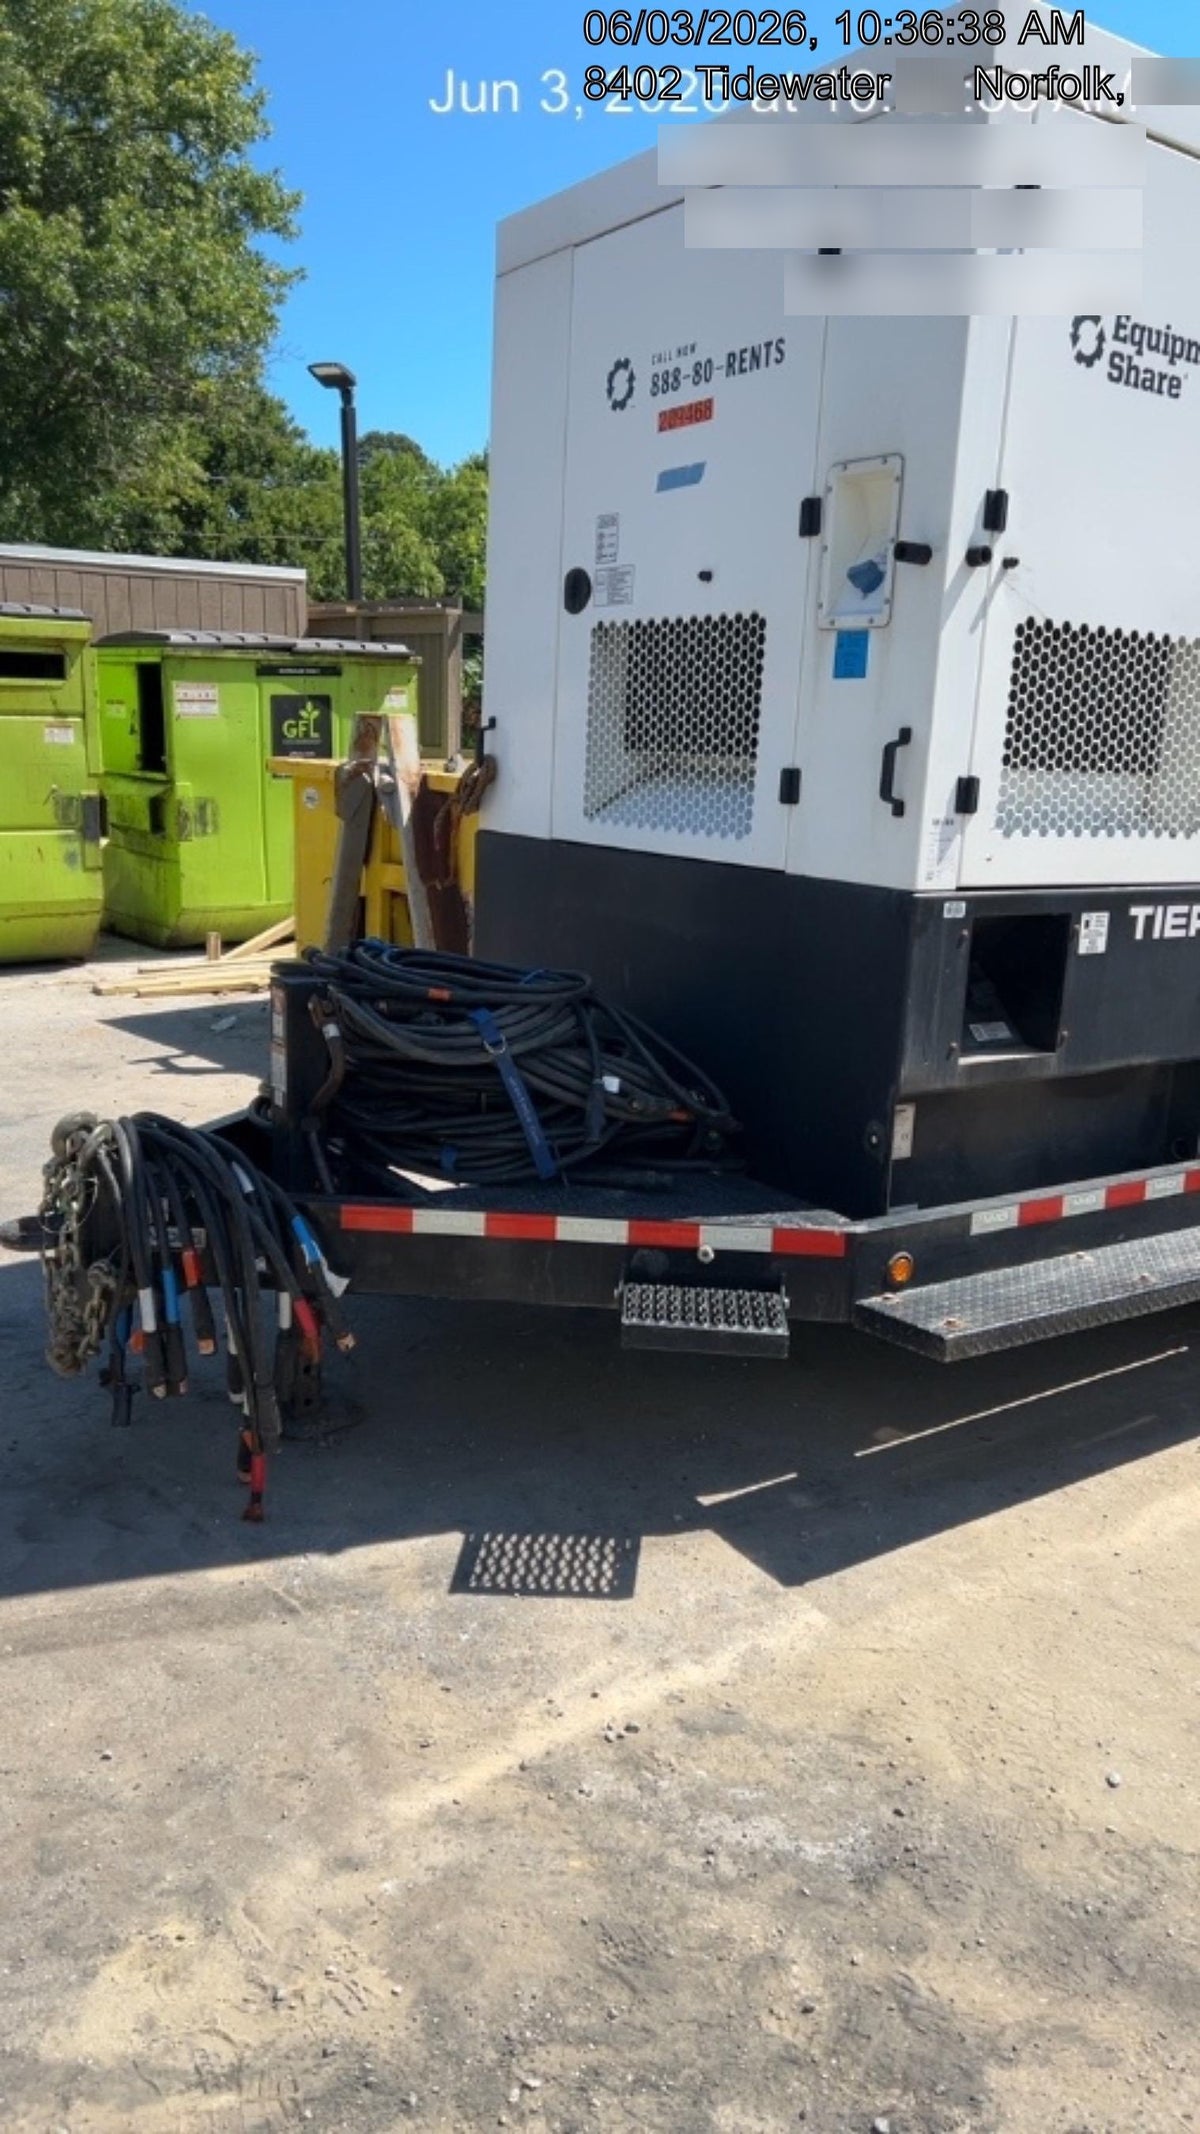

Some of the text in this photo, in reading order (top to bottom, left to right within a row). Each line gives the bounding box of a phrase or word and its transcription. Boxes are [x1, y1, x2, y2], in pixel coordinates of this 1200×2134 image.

[650, 336, 786, 397] 888-80-RENTS
[1107, 350, 1182, 399] Share
[281, 717, 321, 739] GFL
